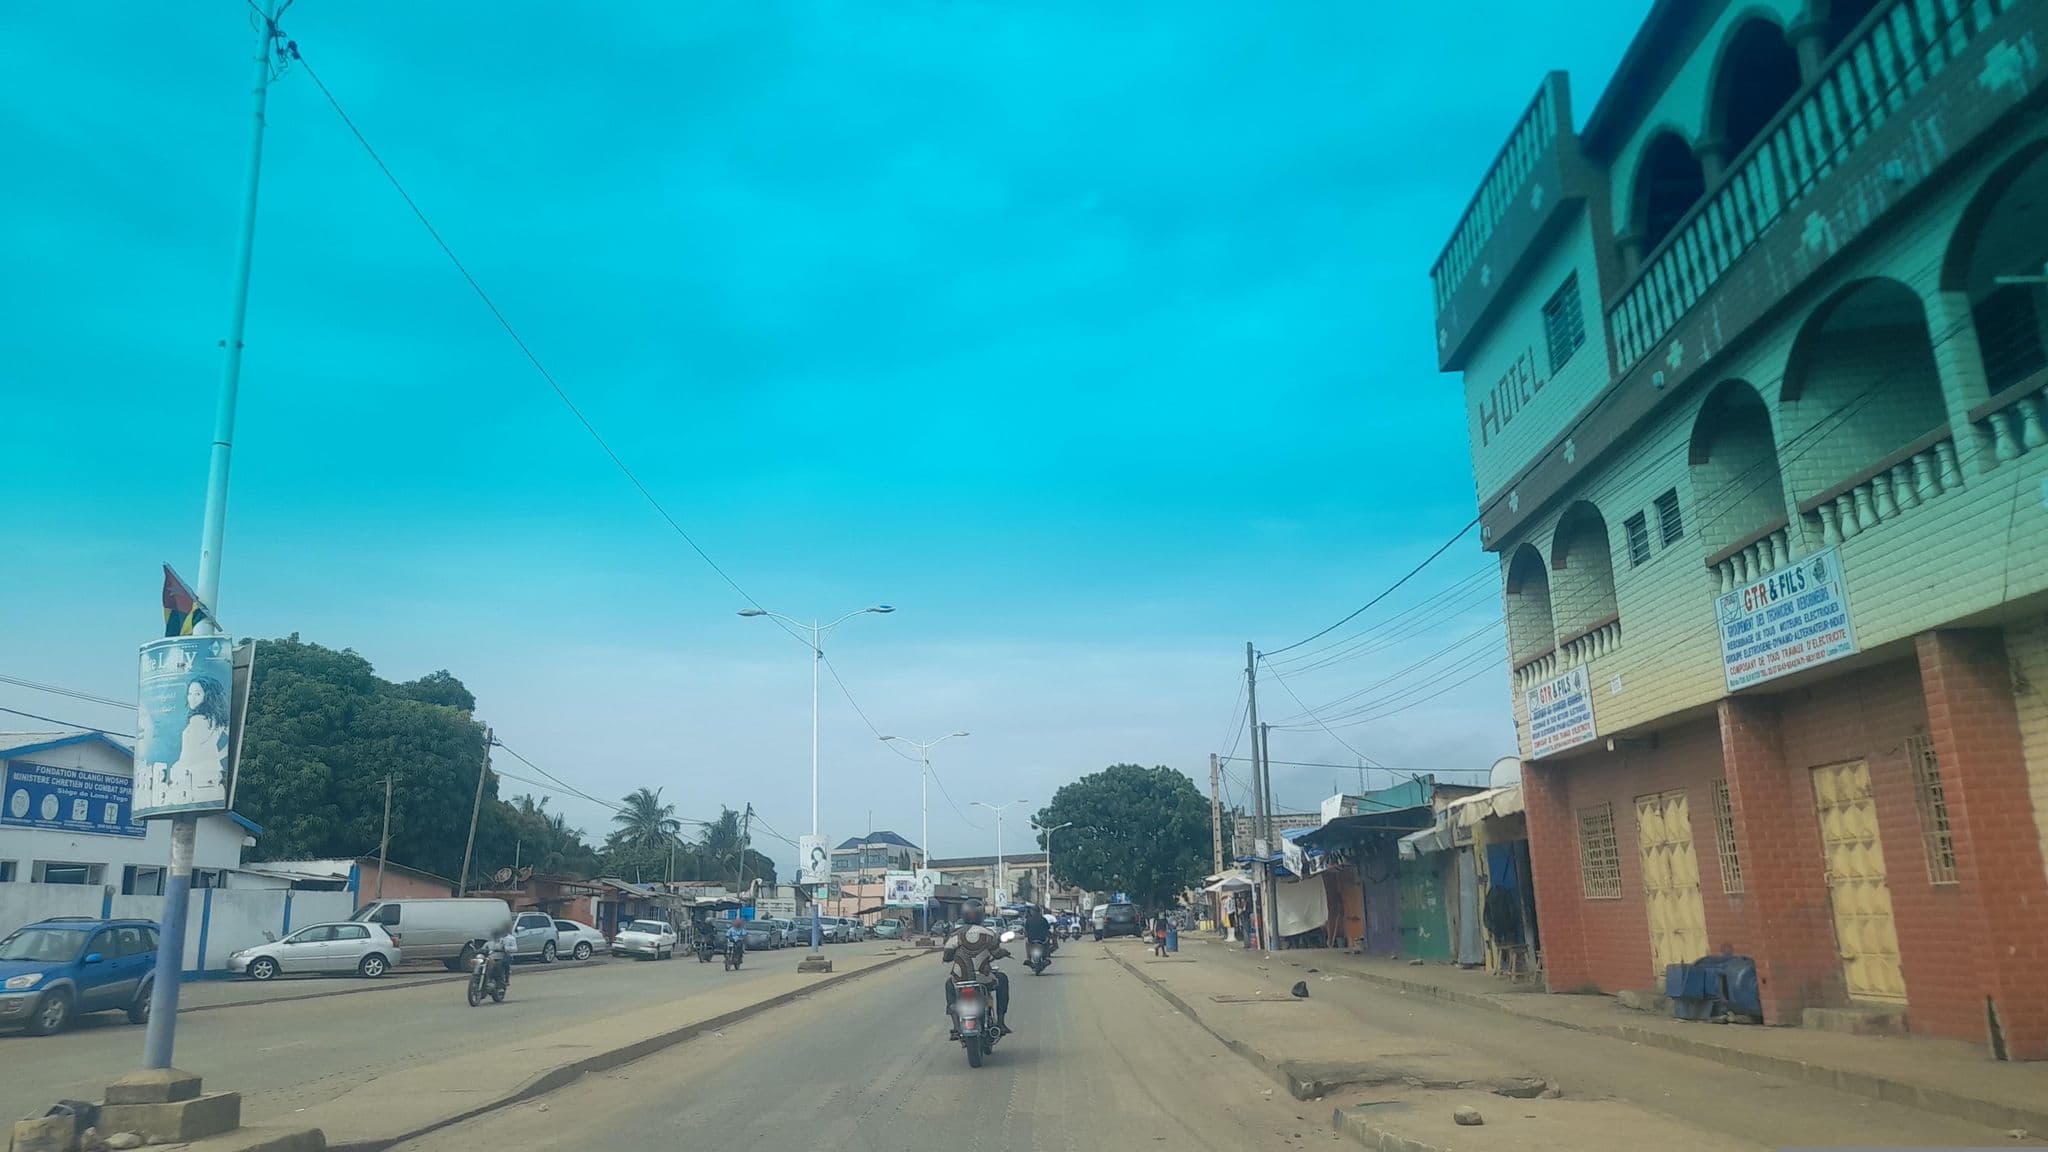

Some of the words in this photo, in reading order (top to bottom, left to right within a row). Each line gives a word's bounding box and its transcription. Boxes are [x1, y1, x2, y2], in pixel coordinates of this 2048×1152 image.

[1480, 344, 1544, 448] HOTEL
[1744, 582, 1768, 612] GTR
[1769, 578, 1778, 601] &
[1778, 566, 1805, 597] FILS
[1763, 626, 1775, 638] TOUS
[1804, 602, 1839, 622] ELECTRIQUES
[1759, 656, 1765, 666] DE
[1767, 651, 1780, 663] TOUS
[1540, 684, 1553, 704] GTR
[1558, 676, 1571, 697] FILS
[14, 772, 51, 784] MINISTERE
[52, 777, 84, 789] CHRETIEN
[85, 782, 92, 790] DU
[94, 784, 118, 793] COMBAT
[36, 766, 76, 778] FONDATION
[79, 772, 104, 782] OLANGI
[105, 776, 128, 786] WOSHO
